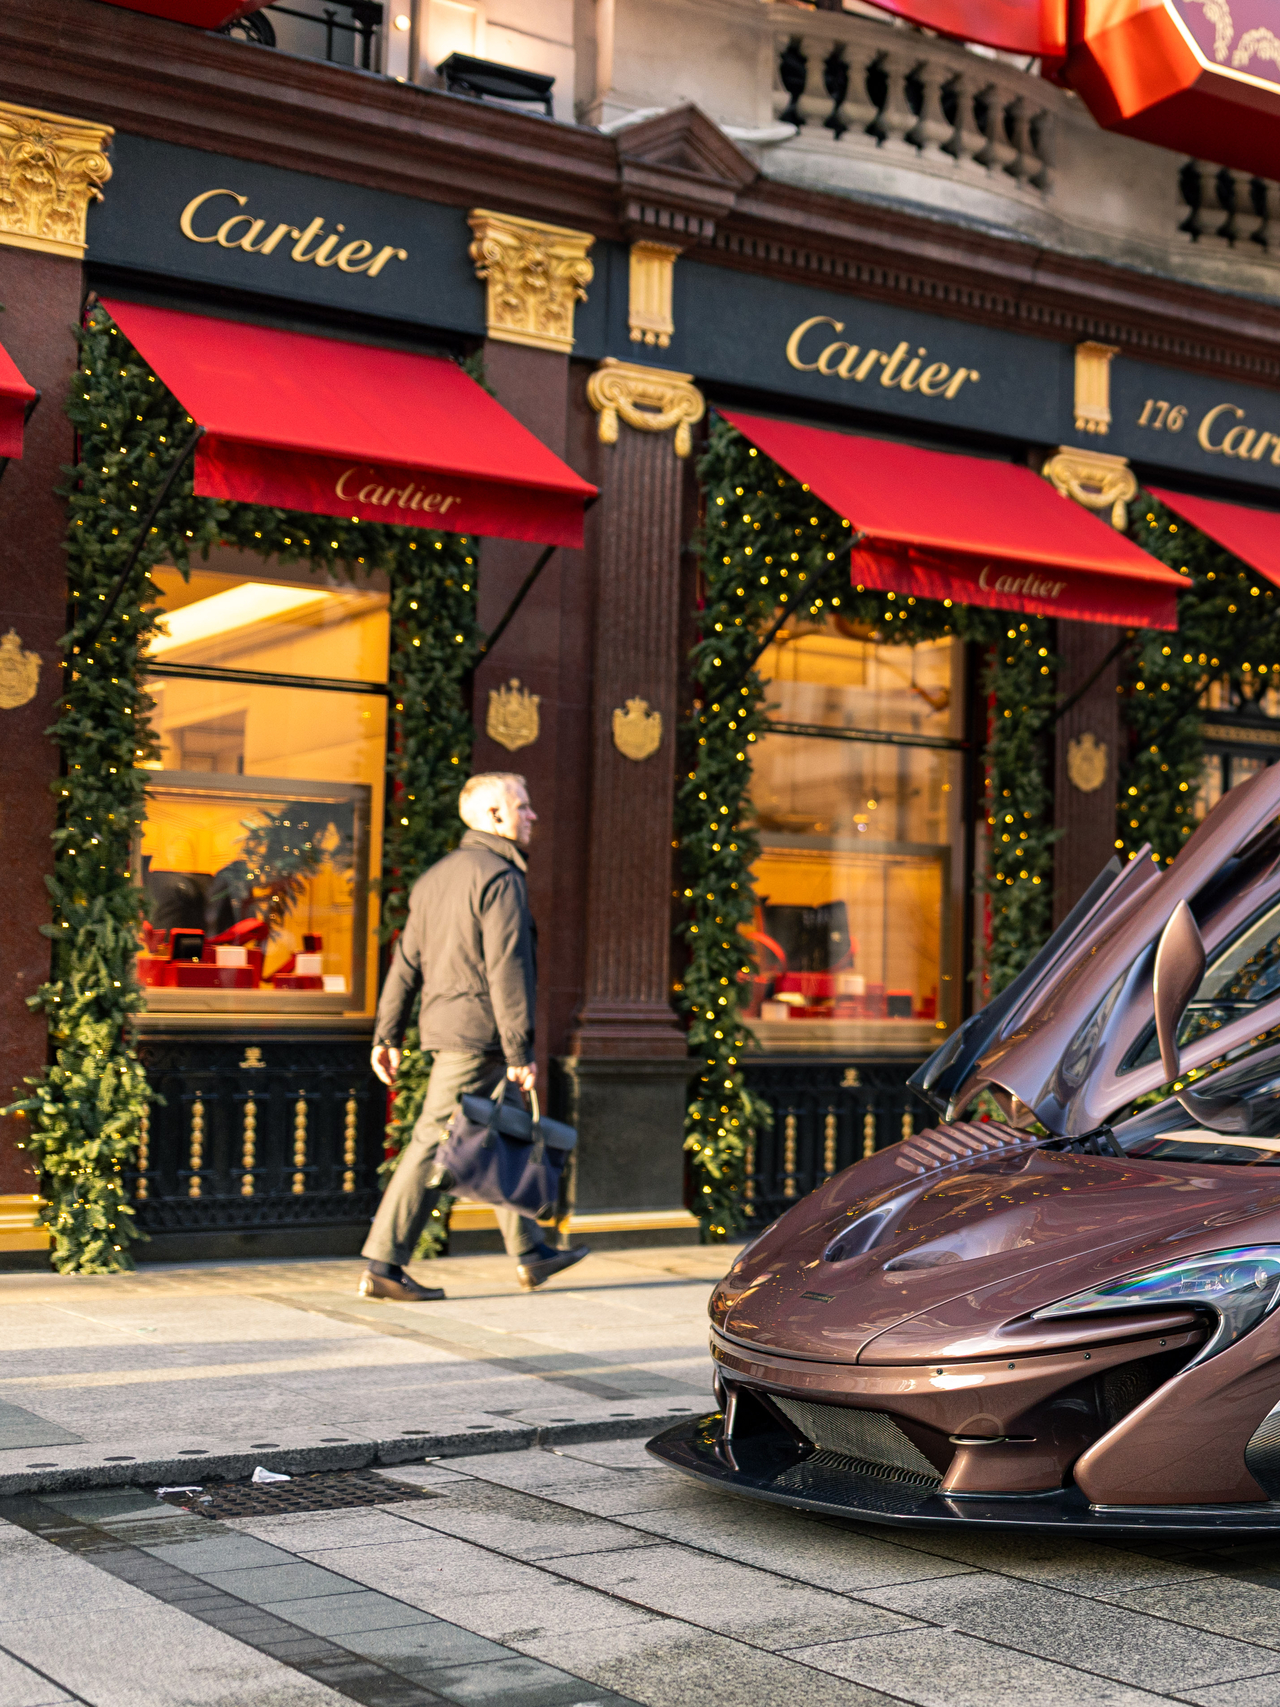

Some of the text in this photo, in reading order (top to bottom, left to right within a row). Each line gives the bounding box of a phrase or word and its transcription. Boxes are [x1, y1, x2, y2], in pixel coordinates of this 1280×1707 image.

[180, 188, 408, 277] Cartier
[786, 315, 980, 399] Cartier
[1137, 399, 1188, 432] 176
[335, 467, 462, 514] Cartier
[979, 564, 1068, 598] Cartier
